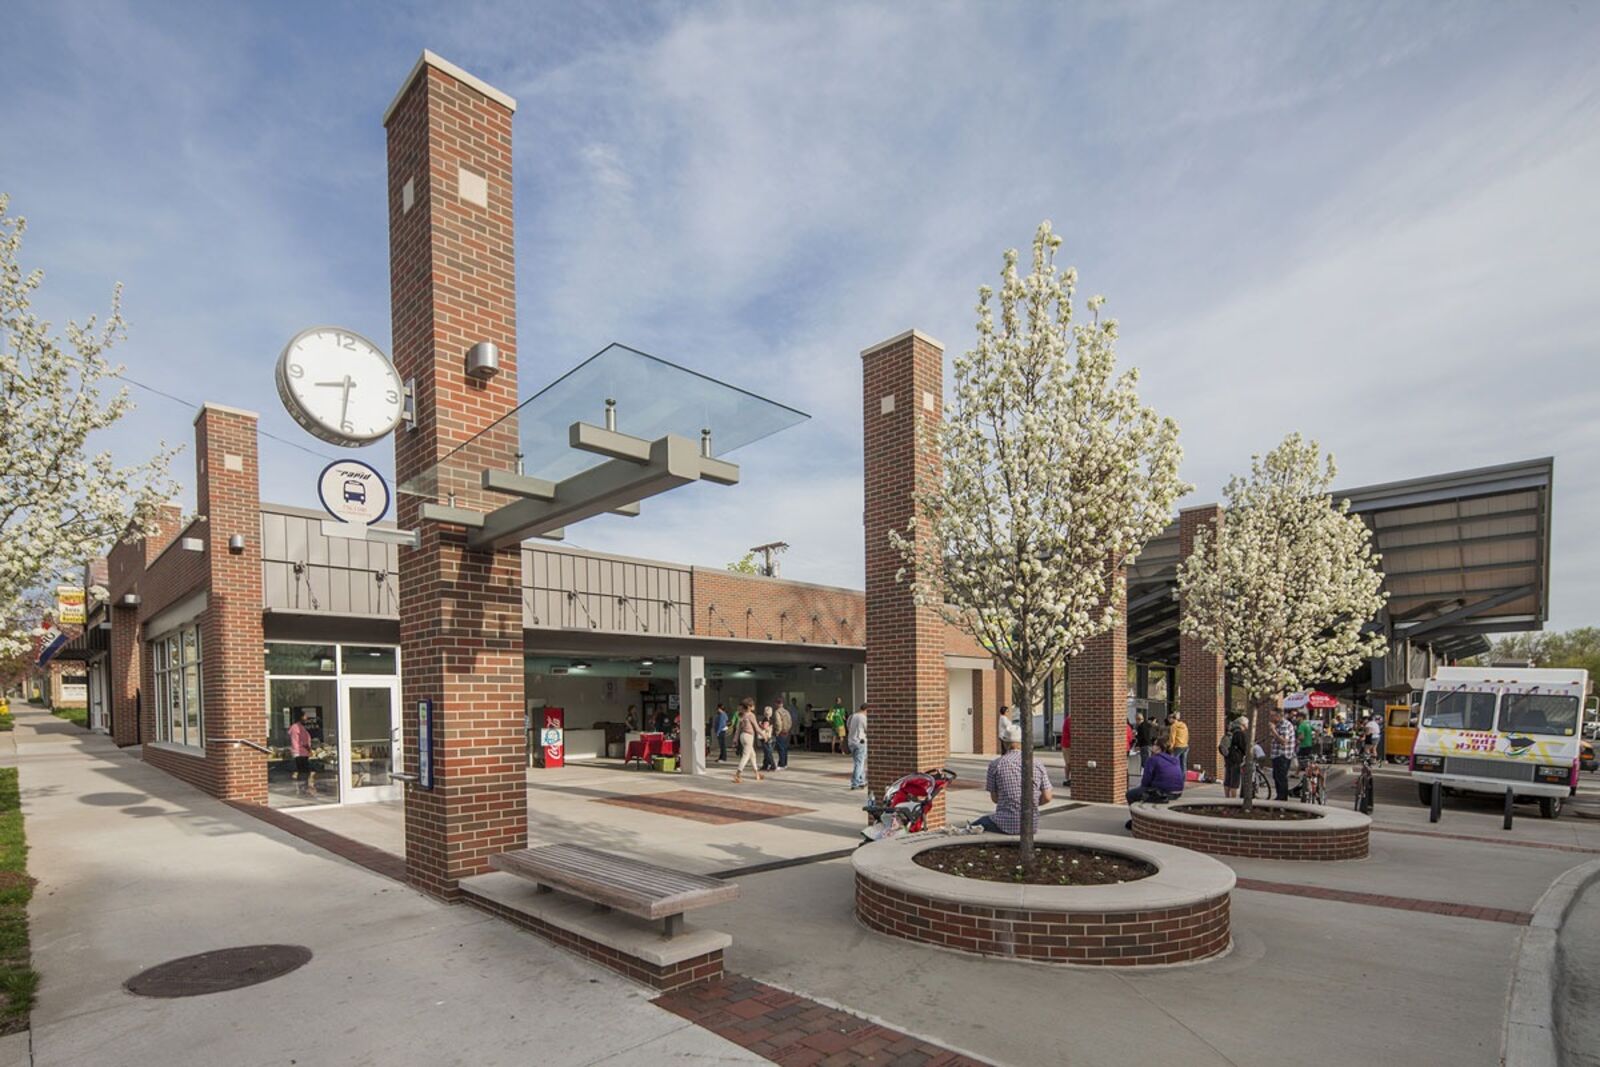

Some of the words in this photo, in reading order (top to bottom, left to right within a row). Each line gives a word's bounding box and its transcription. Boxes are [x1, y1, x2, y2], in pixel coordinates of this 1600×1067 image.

[335, 334, 357, 351] 12
[289, 364, 304, 379] 9
[386, 390, 399, 405] 3
[341, 421, 354, 434] 6
